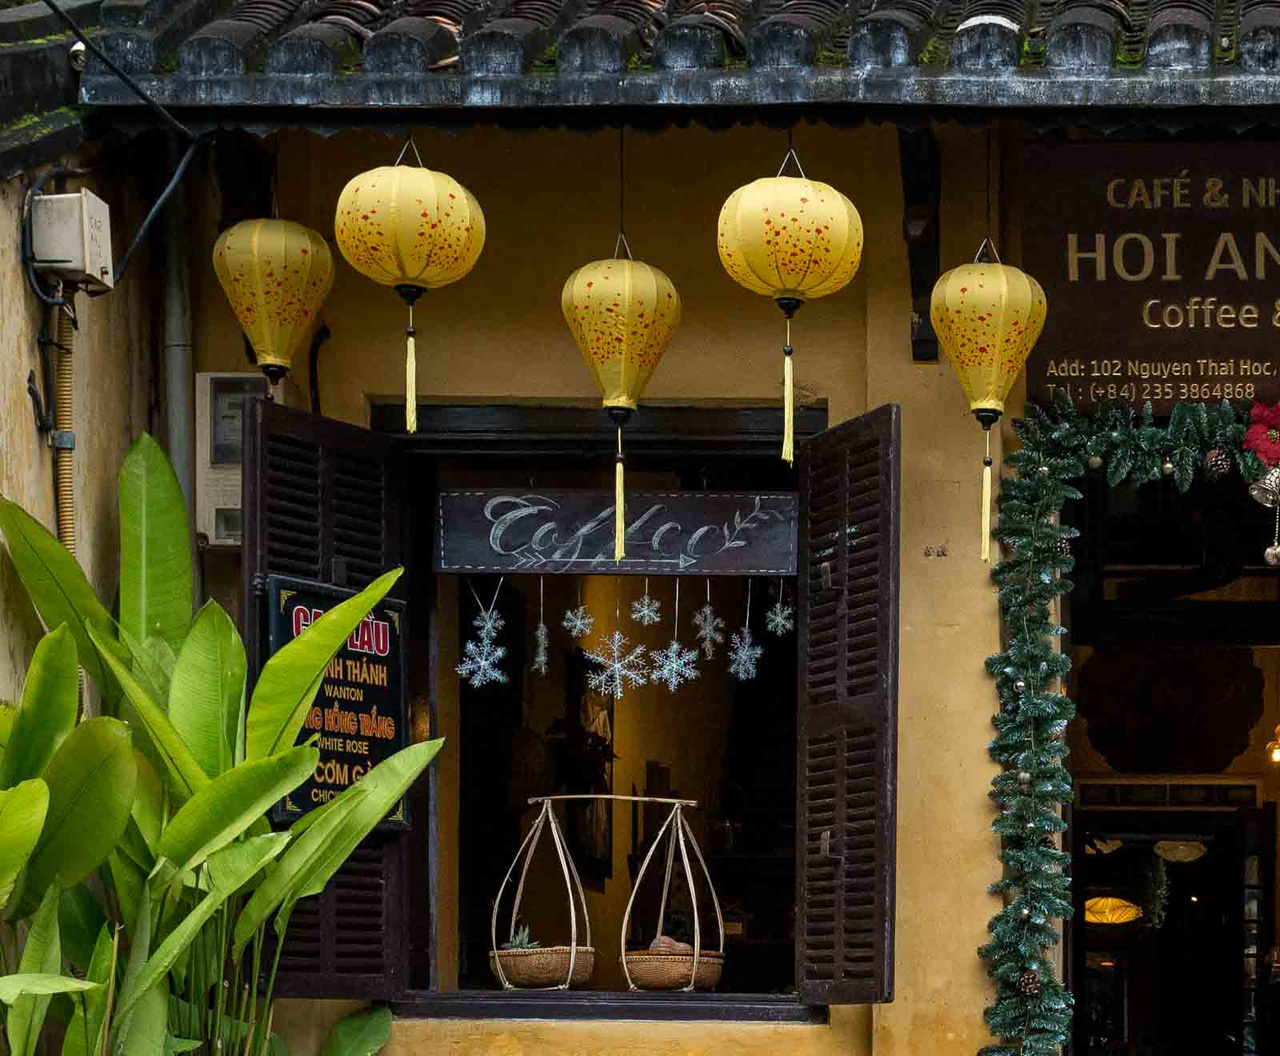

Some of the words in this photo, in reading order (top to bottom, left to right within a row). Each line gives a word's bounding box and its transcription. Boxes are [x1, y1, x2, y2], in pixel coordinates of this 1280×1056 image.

[1106, 169, 1191, 208] CAFÉ
[1202, 178, 1229, 208] &
[1067, 232, 1181, 282] HOI
[1143, 297, 1259, 328] Coffee
[1046, 359, 1085, 377] Add:
[1090, 359, 1122, 377] 102
[1128, 359, 1192, 380] Nguyen
[1197, 359, 1235, 377] Thai
[1090, 382, 1136, 402] (+84)
[1142, 383, 1174, 399] 235
[1178, 383, 1256, 399] 3864868
[324, 683, 363, 701] WANTON
[318, 737, 344, 751] WHITE
[346, 740, 369, 754] ROSE
